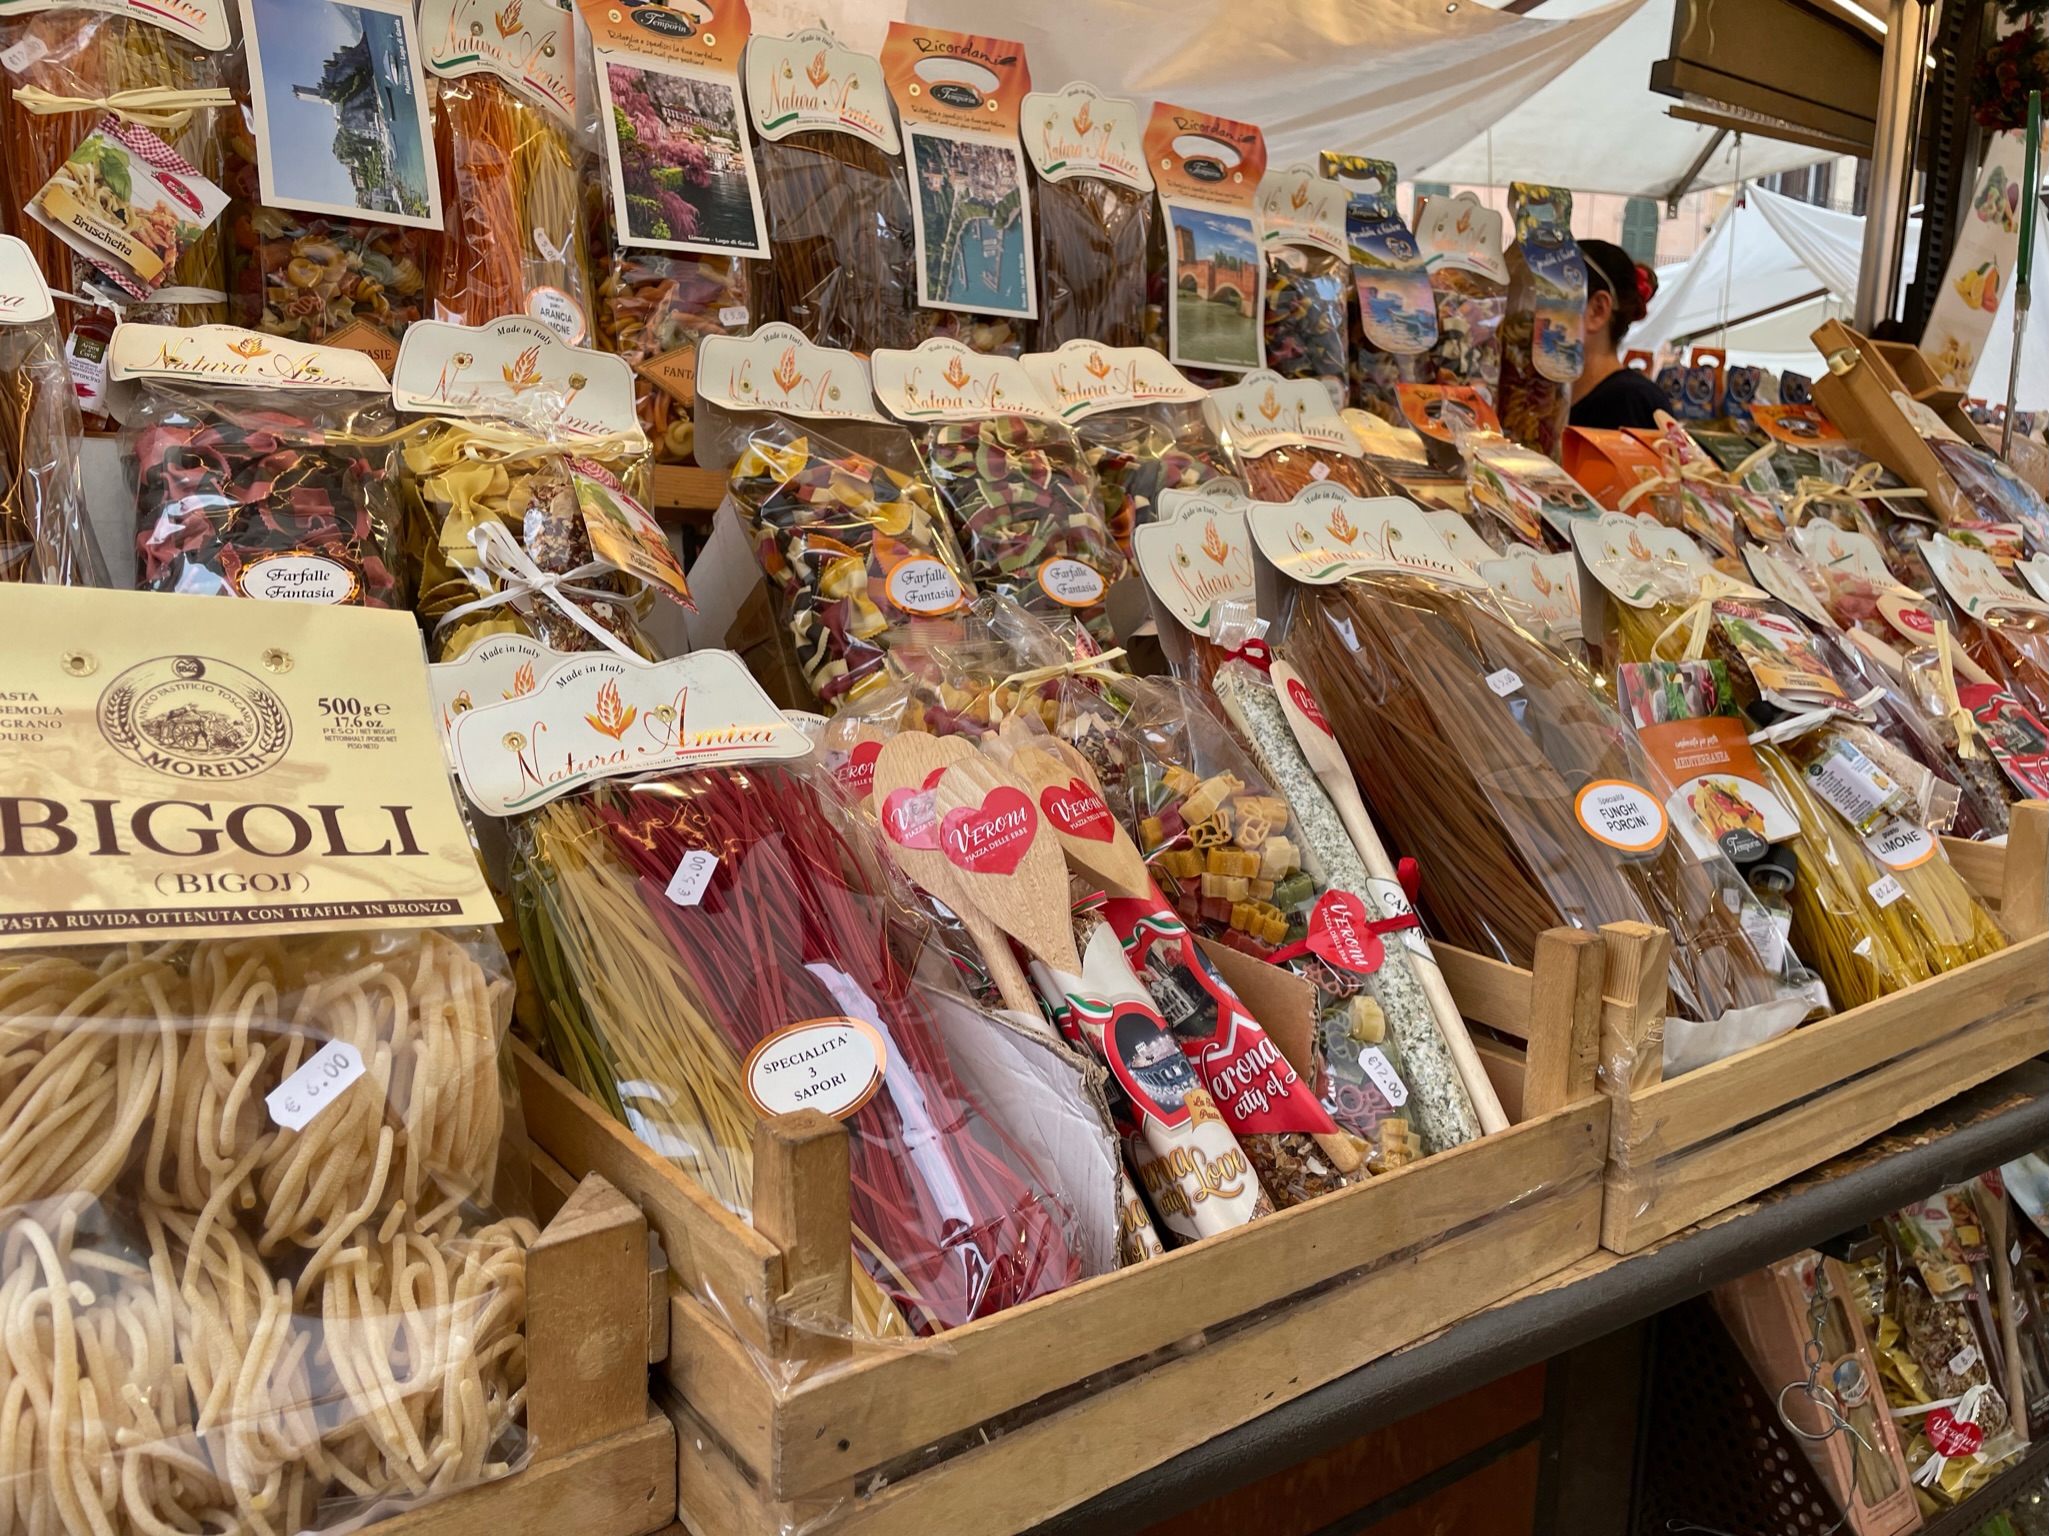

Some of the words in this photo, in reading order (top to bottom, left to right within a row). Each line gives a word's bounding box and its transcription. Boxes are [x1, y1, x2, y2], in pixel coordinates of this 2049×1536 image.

[640, 11, 686, 33] Temporin
[913, 38, 1000, 66] Ricordami
[762, 58, 819, 120] Natura
[938, 87, 976, 105] Temporin
[1173, 116, 1243, 143] Ricordami
[72, 214, 133, 257] Bruschetta
[688, 234, 710, 242] Limone
[715, 237, 729, 245] Lago
[540, 308, 572, 323] ARANCIA
[497, 325, 521, 336] Made
[522, 325, 532, 335] in
[533, 328, 552, 345] Italy
[763, 331, 780, 344] Made
[128, 337, 250, 375] Natura
[1304, 493, 1323, 505] Made
[1331, 491, 1347, 503] Italy
[1181, 508, 1196, 521] Made
[1203, 505, 1217, 517] Italy
[1363, 520, 1455, 573] Amica
[266, 568, 330, 586] Farfalle
[901, 567, 947, 593] Farfalle
[1050, 564, 1088, 582] Farfalle
[1168, 543, 1235, 617] Natura
[265, 585, 334, 598] Fantasia
[904, 589, 954, 604] Fantasia
[1056, 581, 1097, 595] Fantasia
[479, 647, 504, 664] Made
[505, 644, 515, 652] in
[518, 645, 541, 660] Italy
[555, 668, 583, 690] Made
[585, 665, 597, 674] in
[600, 663, 626, 675] Italy
[0, 692, 39, 701] ASTA
[139, 694, 158, 721] ANTICO
[157, 683, 214, 697] PASTIFICIO
[218, 690, 253, 723] TOSCANO
[1, 719, 62, 729] GRANO
[334, 716, 363, 728] 17.6
[502, 721, 630, 802] Natura
[638, 686, 778, 755] Amica
[144, 751, 267, 777] MORELLI
[1673, 751, 1730, 769] MEDITERRANEA
[1599, 803, 1639, 820] FUNGHI
[0, 797, 429, 857] BIGOLI
[905, 824, 929, 840] PIAZZA
[1606, 815, 1649, 832] PORCINI
[965, 847, 988, 863] PIAZZA
[989, 836, 1010, 851] DELLE
[1010, 827, 1028, 841] ERBE
[1726, 833, 1762, 855] Temporin
[1877, 830, 1921, 854] LIMONE
[0, 916, 59, 931] PASTA
[66, 913, 140, 928] RUVIDA
[146, 910, 243, 925] OTTENUTA
[248, 908, 285, 921] CON
[289, 904, 360, 918] TRAFILA
[364, 904, 383, 914] IN
[388, 902, 452, 914] BRONZO
[763, 1032, 848, 1075] SPECIALITA'
[808, 1066, 817, 1078] 3
[1368, 1054, 1402, 1099] €12.00
[794, 1073, 847, 1102] SAPORI
[1234, 1084, 1269, 1120] city
[1267, 1070, 1289, 1097] of
[1188, 1145, 1247, 1203] Love
